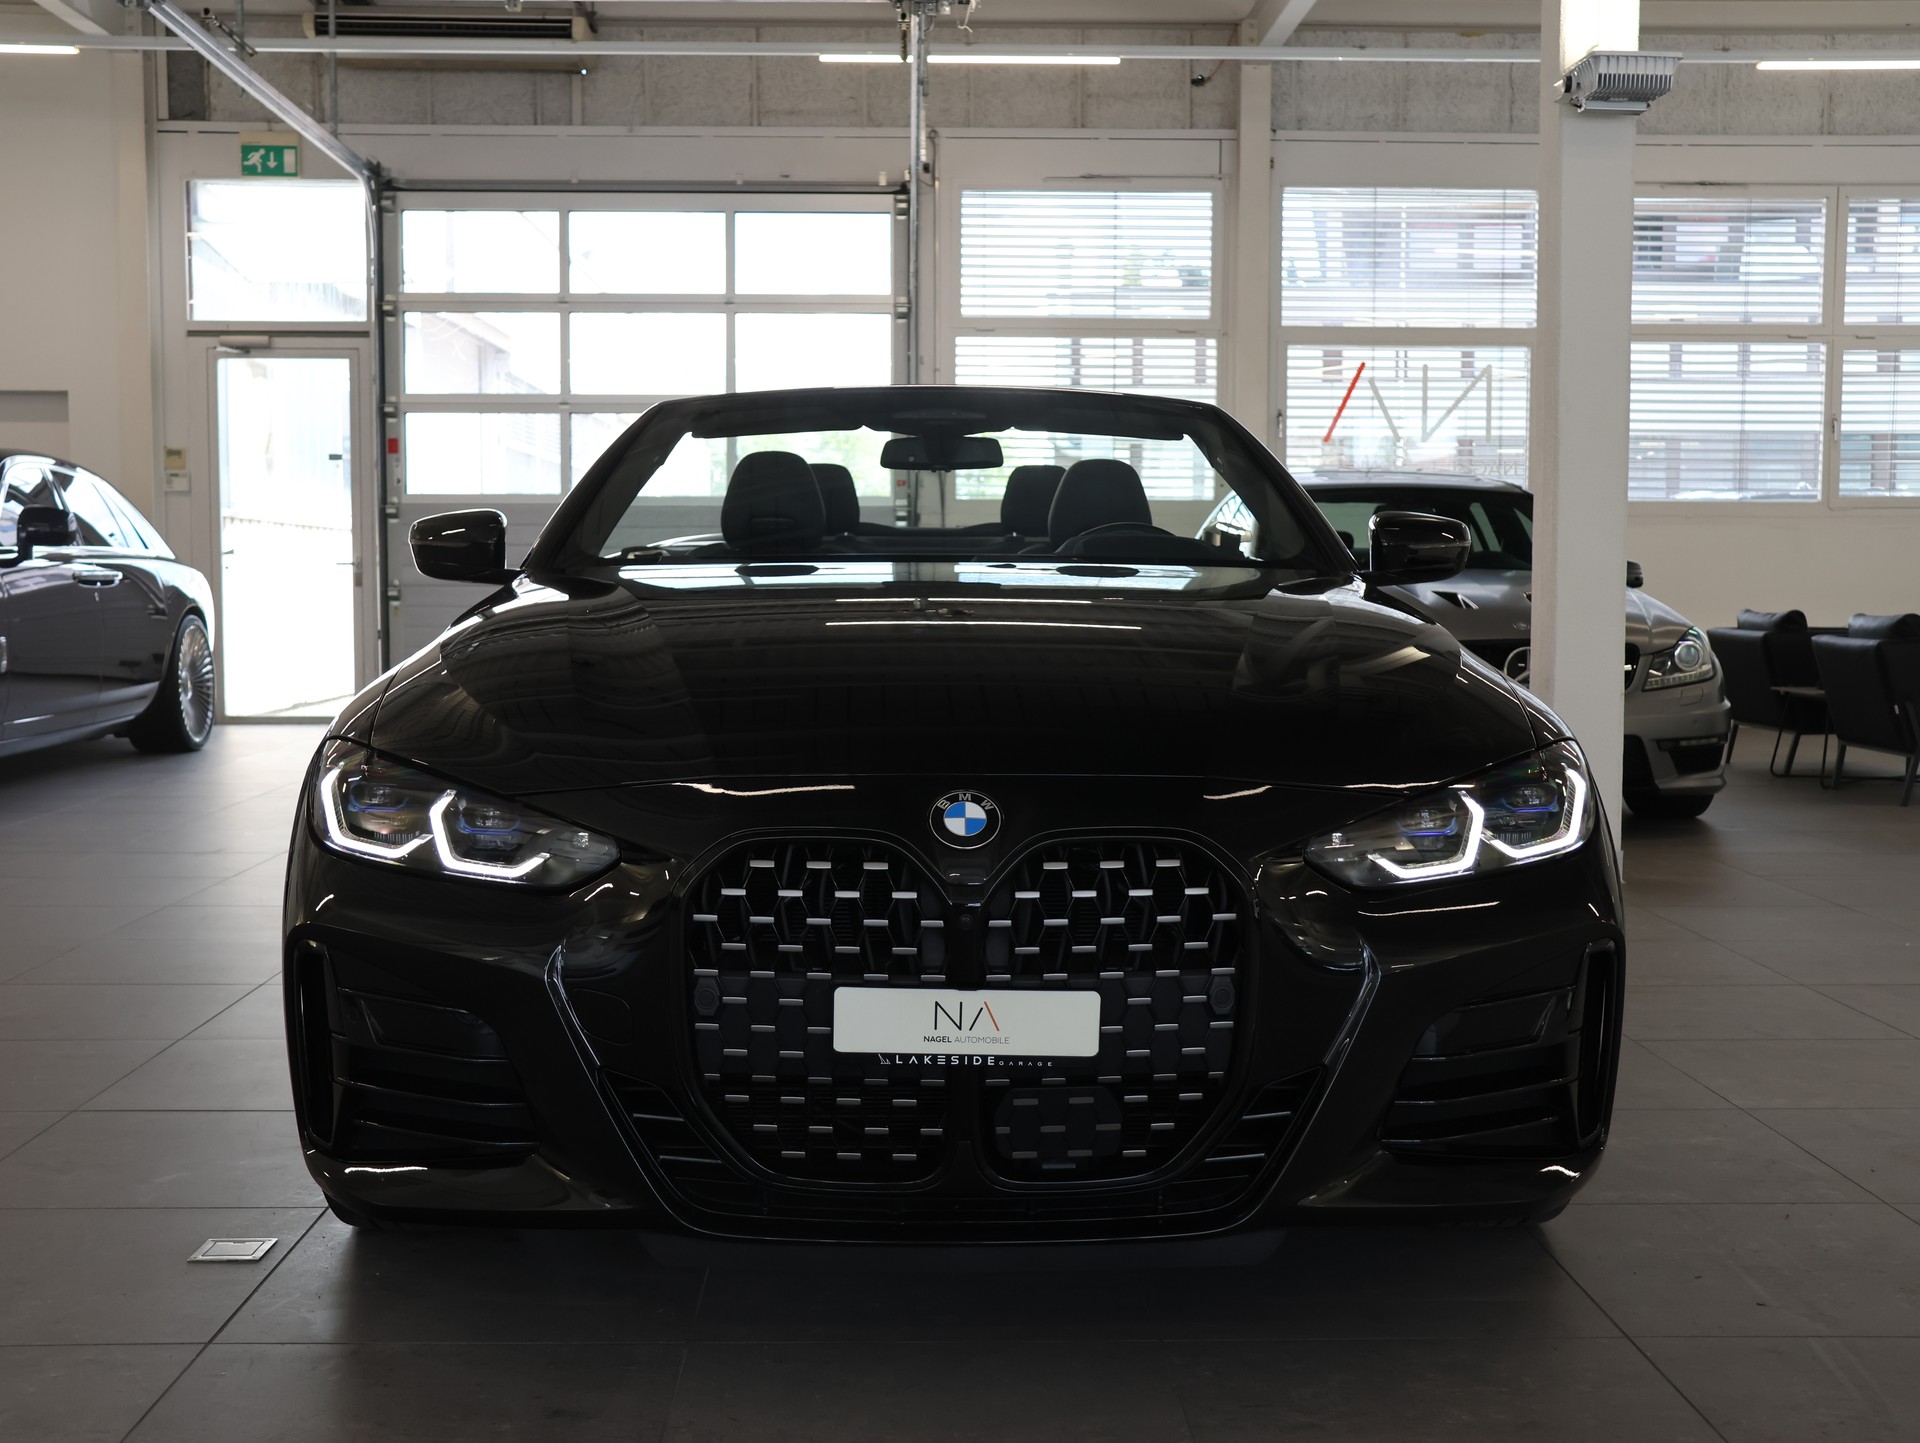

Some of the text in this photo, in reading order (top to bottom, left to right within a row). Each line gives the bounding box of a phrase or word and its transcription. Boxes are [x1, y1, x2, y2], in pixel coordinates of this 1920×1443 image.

[937, 793, 994, 810] BMW
[934, 1000, 1000, 1032] NA
[923, 1035, 1010, 1045] NAGEL AUTOMOBILE
[895, 1054, 995, 1066] LAKESIDE
